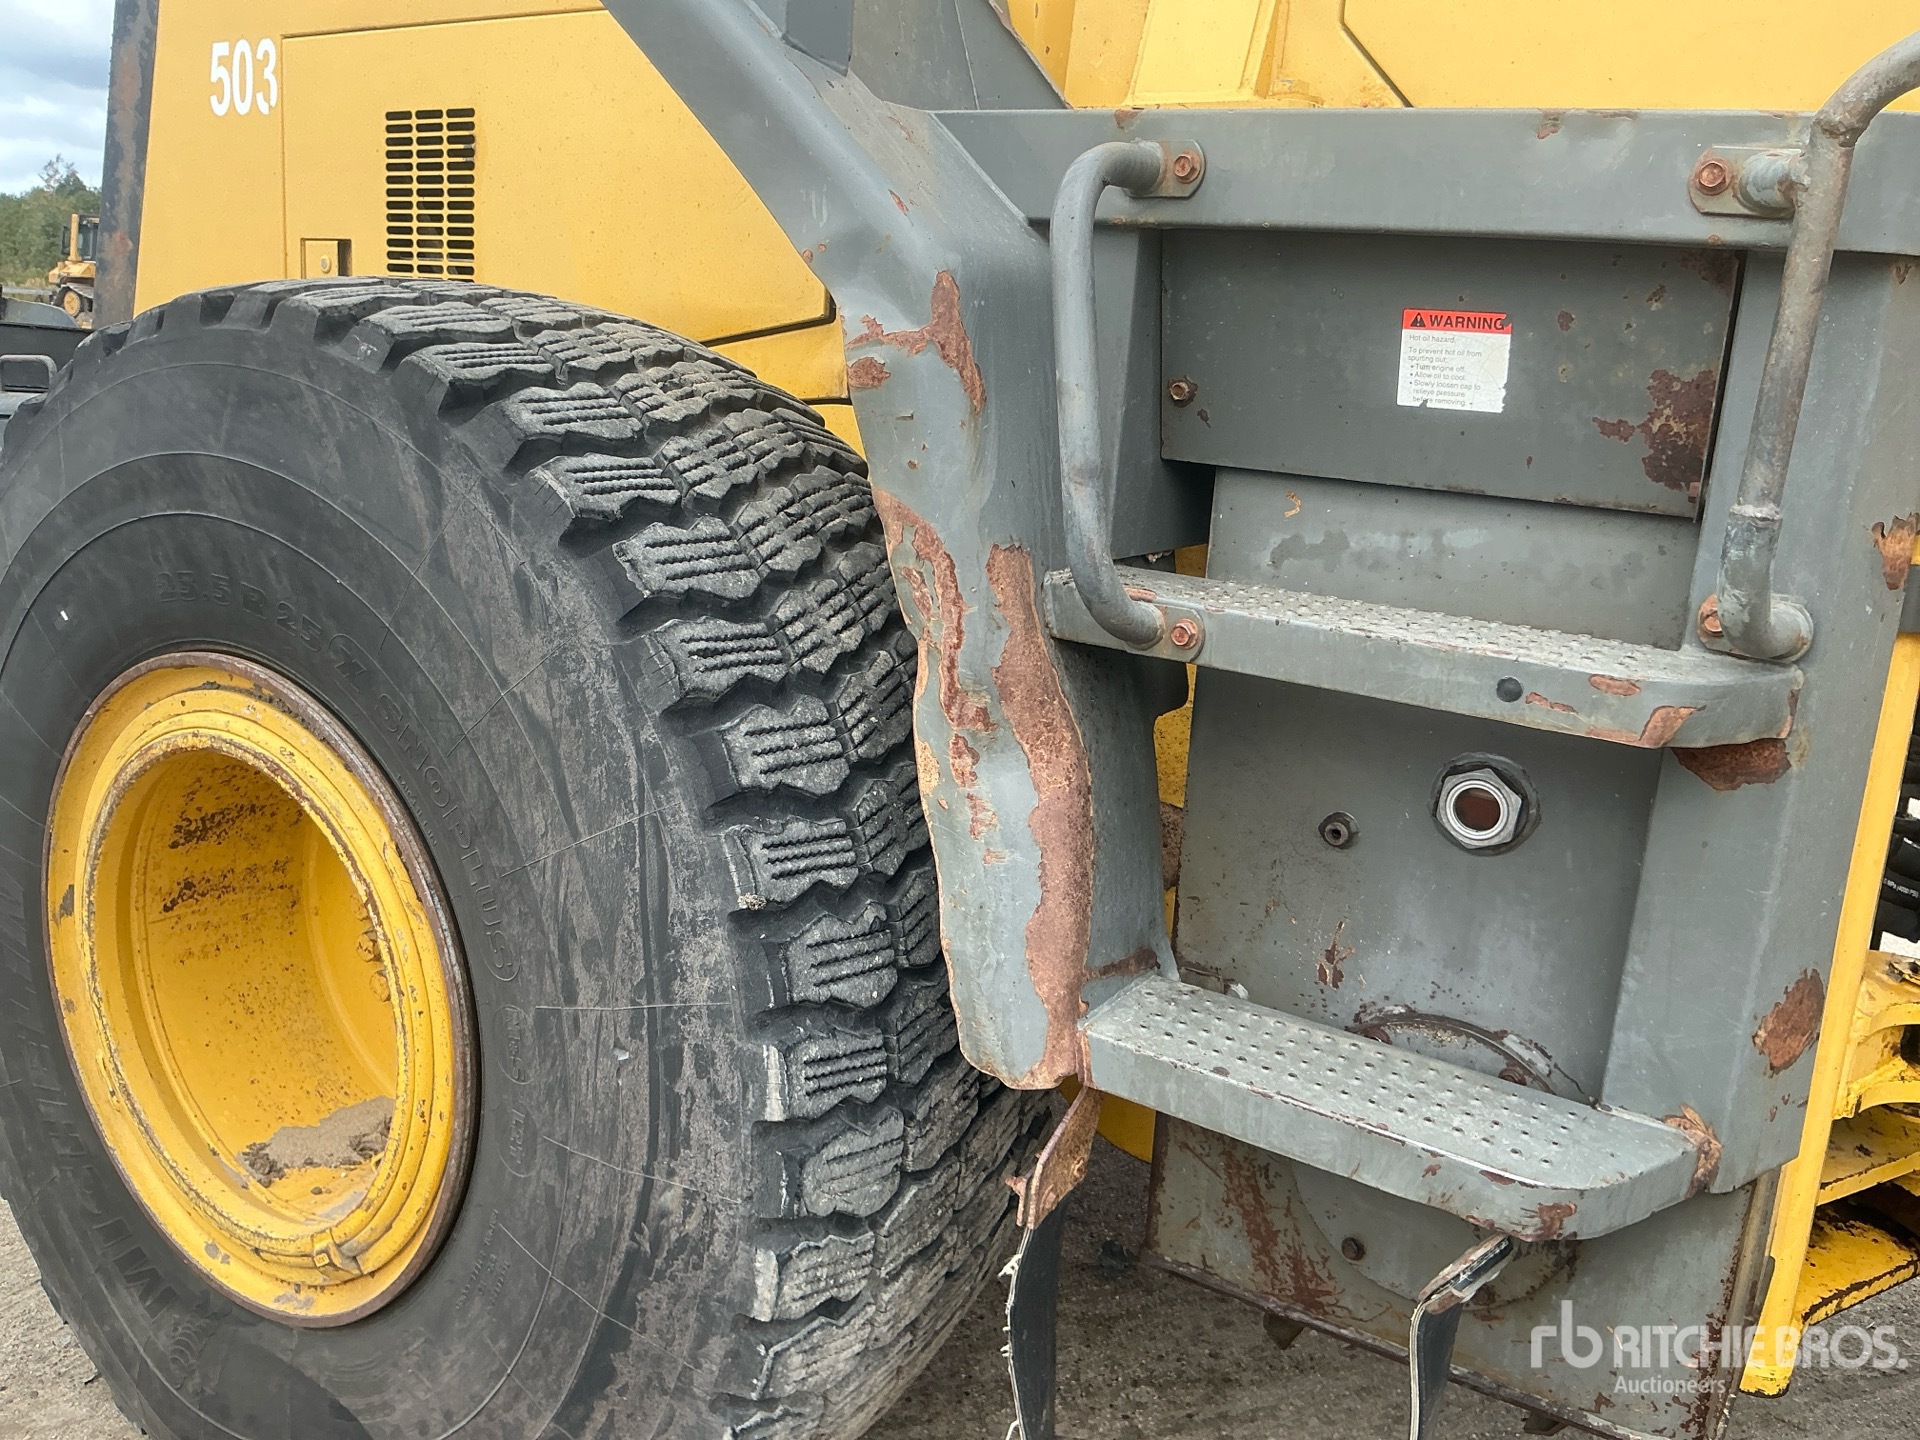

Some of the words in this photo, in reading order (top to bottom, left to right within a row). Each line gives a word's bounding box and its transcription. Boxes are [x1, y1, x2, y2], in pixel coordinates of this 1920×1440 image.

[209, 37, 278, 117] 503
[1429, 315, 1505, 331] WARNING
[1418, 348, 1443, 356] prevent
[1407, 355, 1433, 363] spurting
[1415, 363, 1431, 371] Turn
[1431, 365, 1454, 373] engine
[1413, 380, 1435, 388] Slowly
[1459, 383, 1472, 391] cap
[1412, 387, 1434, 396] relieve
[1435, 389, 1466, 397] pressure
